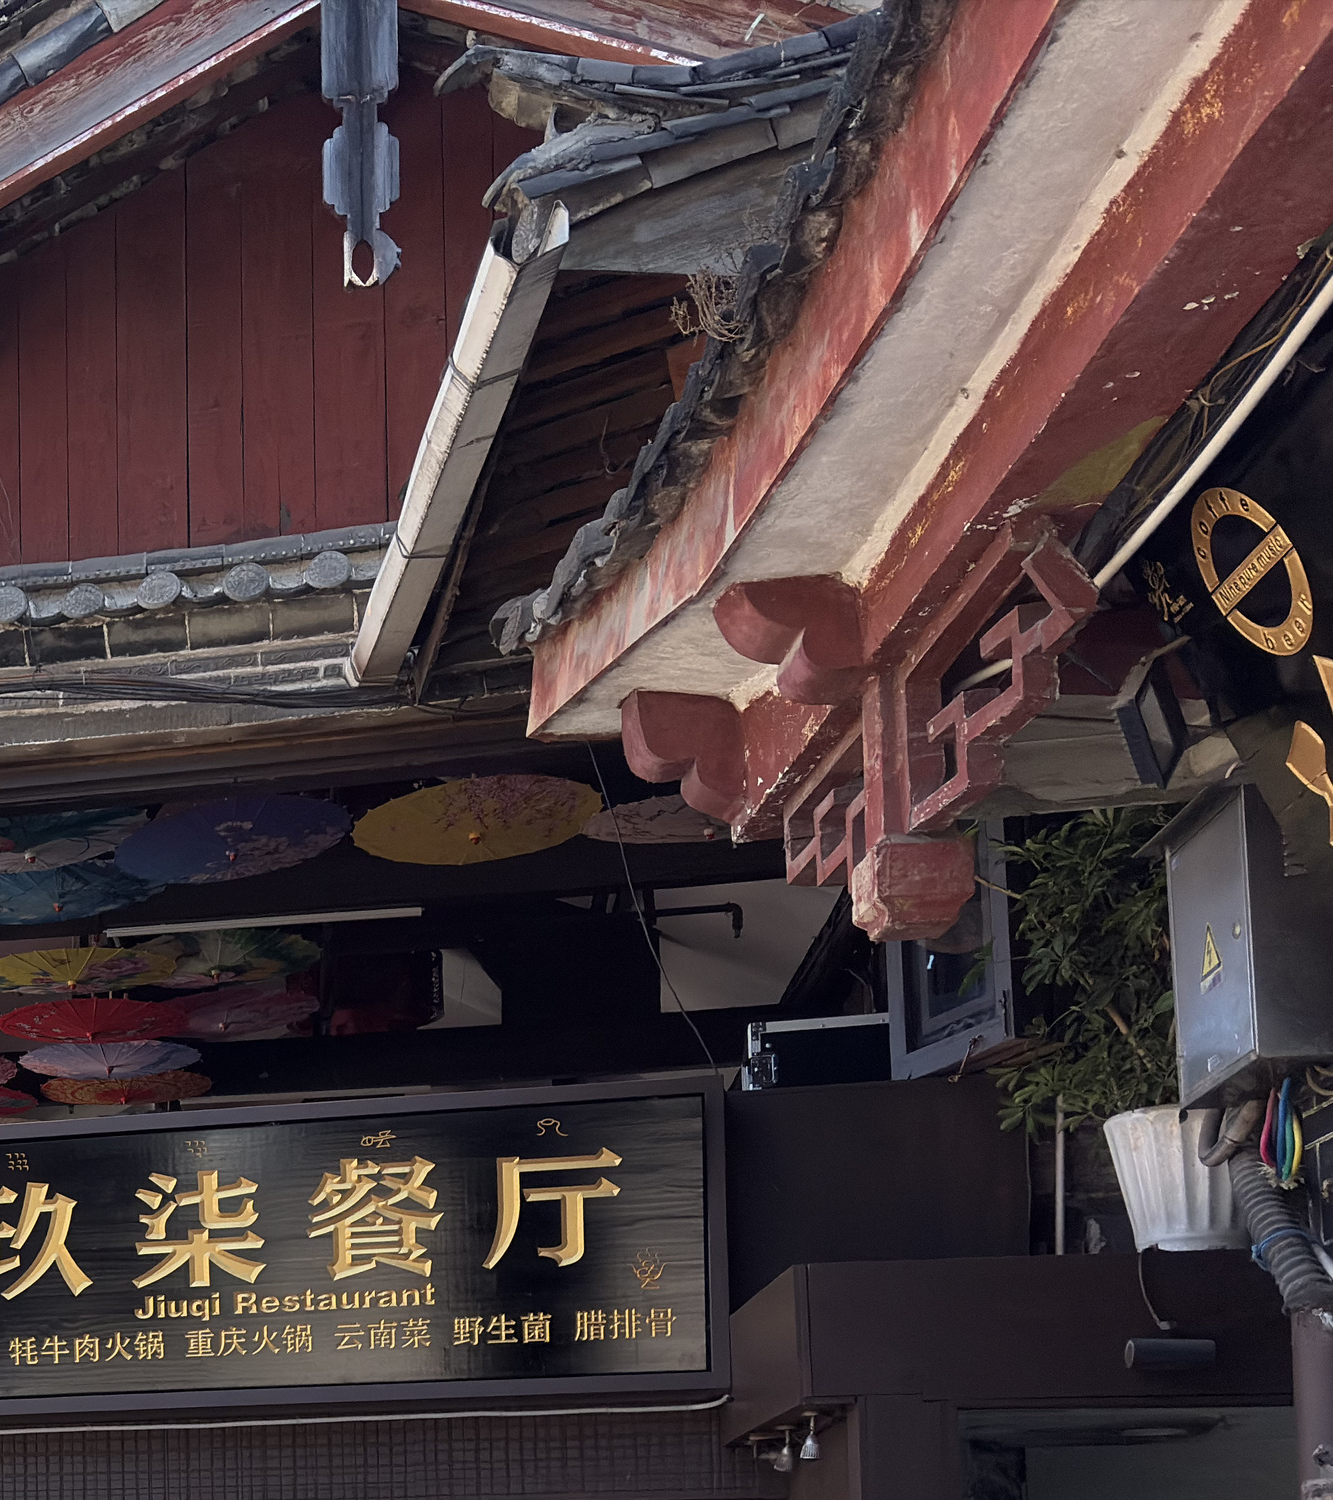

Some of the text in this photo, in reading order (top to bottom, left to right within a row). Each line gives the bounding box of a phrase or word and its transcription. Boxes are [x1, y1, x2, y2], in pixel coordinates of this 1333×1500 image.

[1263, 592, 1313, 651] beer
[134, 1282, 435, 1322] Jiuqi Restaurant
[8, 1330, 165, 1366] 牦牛肉火锅
[184, 1323, 313, 1358] 重庆火锅
[334, 1317, 432, 1351] 云南菜
[453, 1310, 553, 1346] 野生菌
[574, 1307, 677, 1342] 腊排骨
